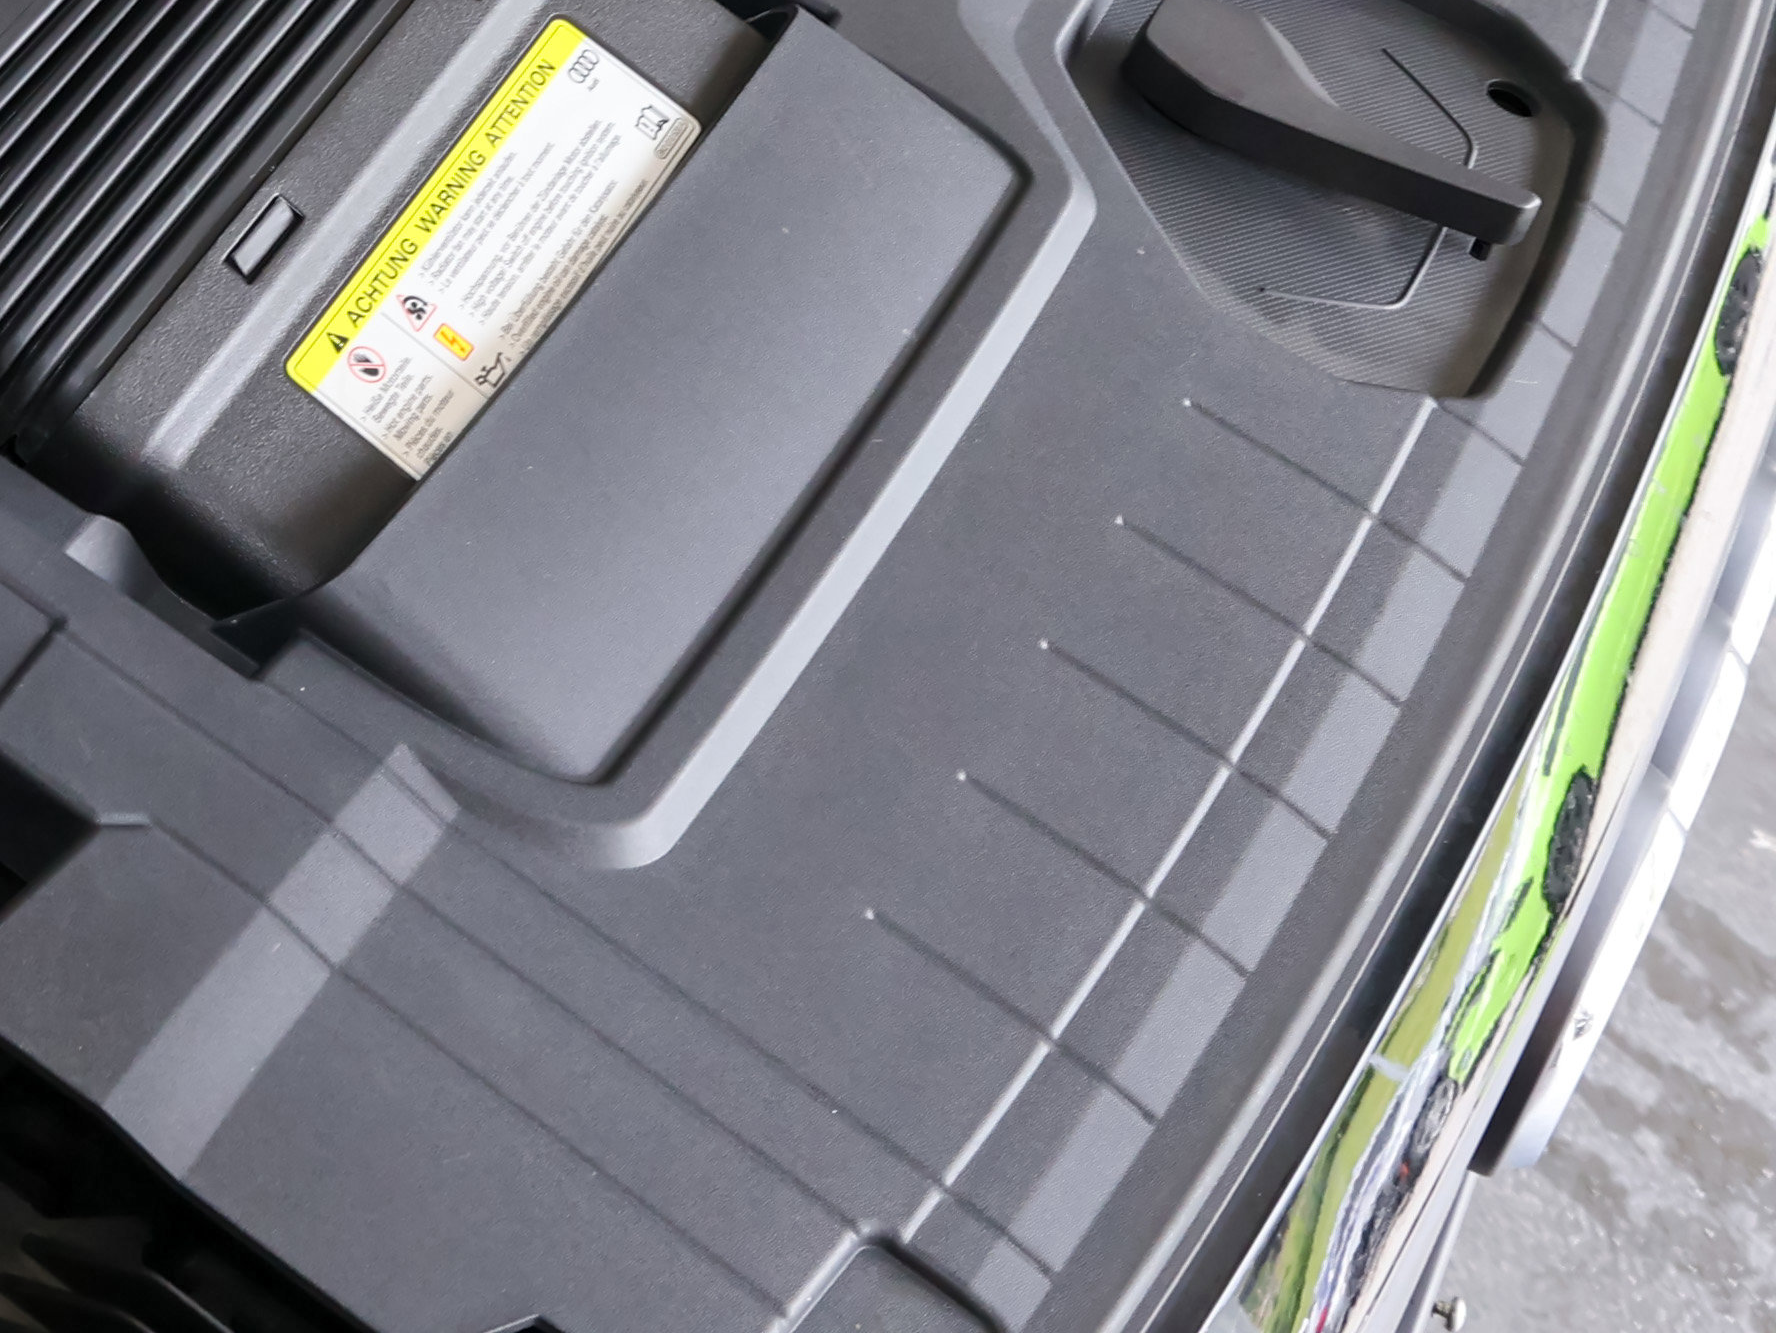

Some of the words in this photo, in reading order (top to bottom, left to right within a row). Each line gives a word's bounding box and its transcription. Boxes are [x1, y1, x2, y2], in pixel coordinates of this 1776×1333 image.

[343, 235, 419, 329] ACHTUNG
[413, 147, 487, 236] WARNING
[481, 57, 556, 148] ATTENTION
